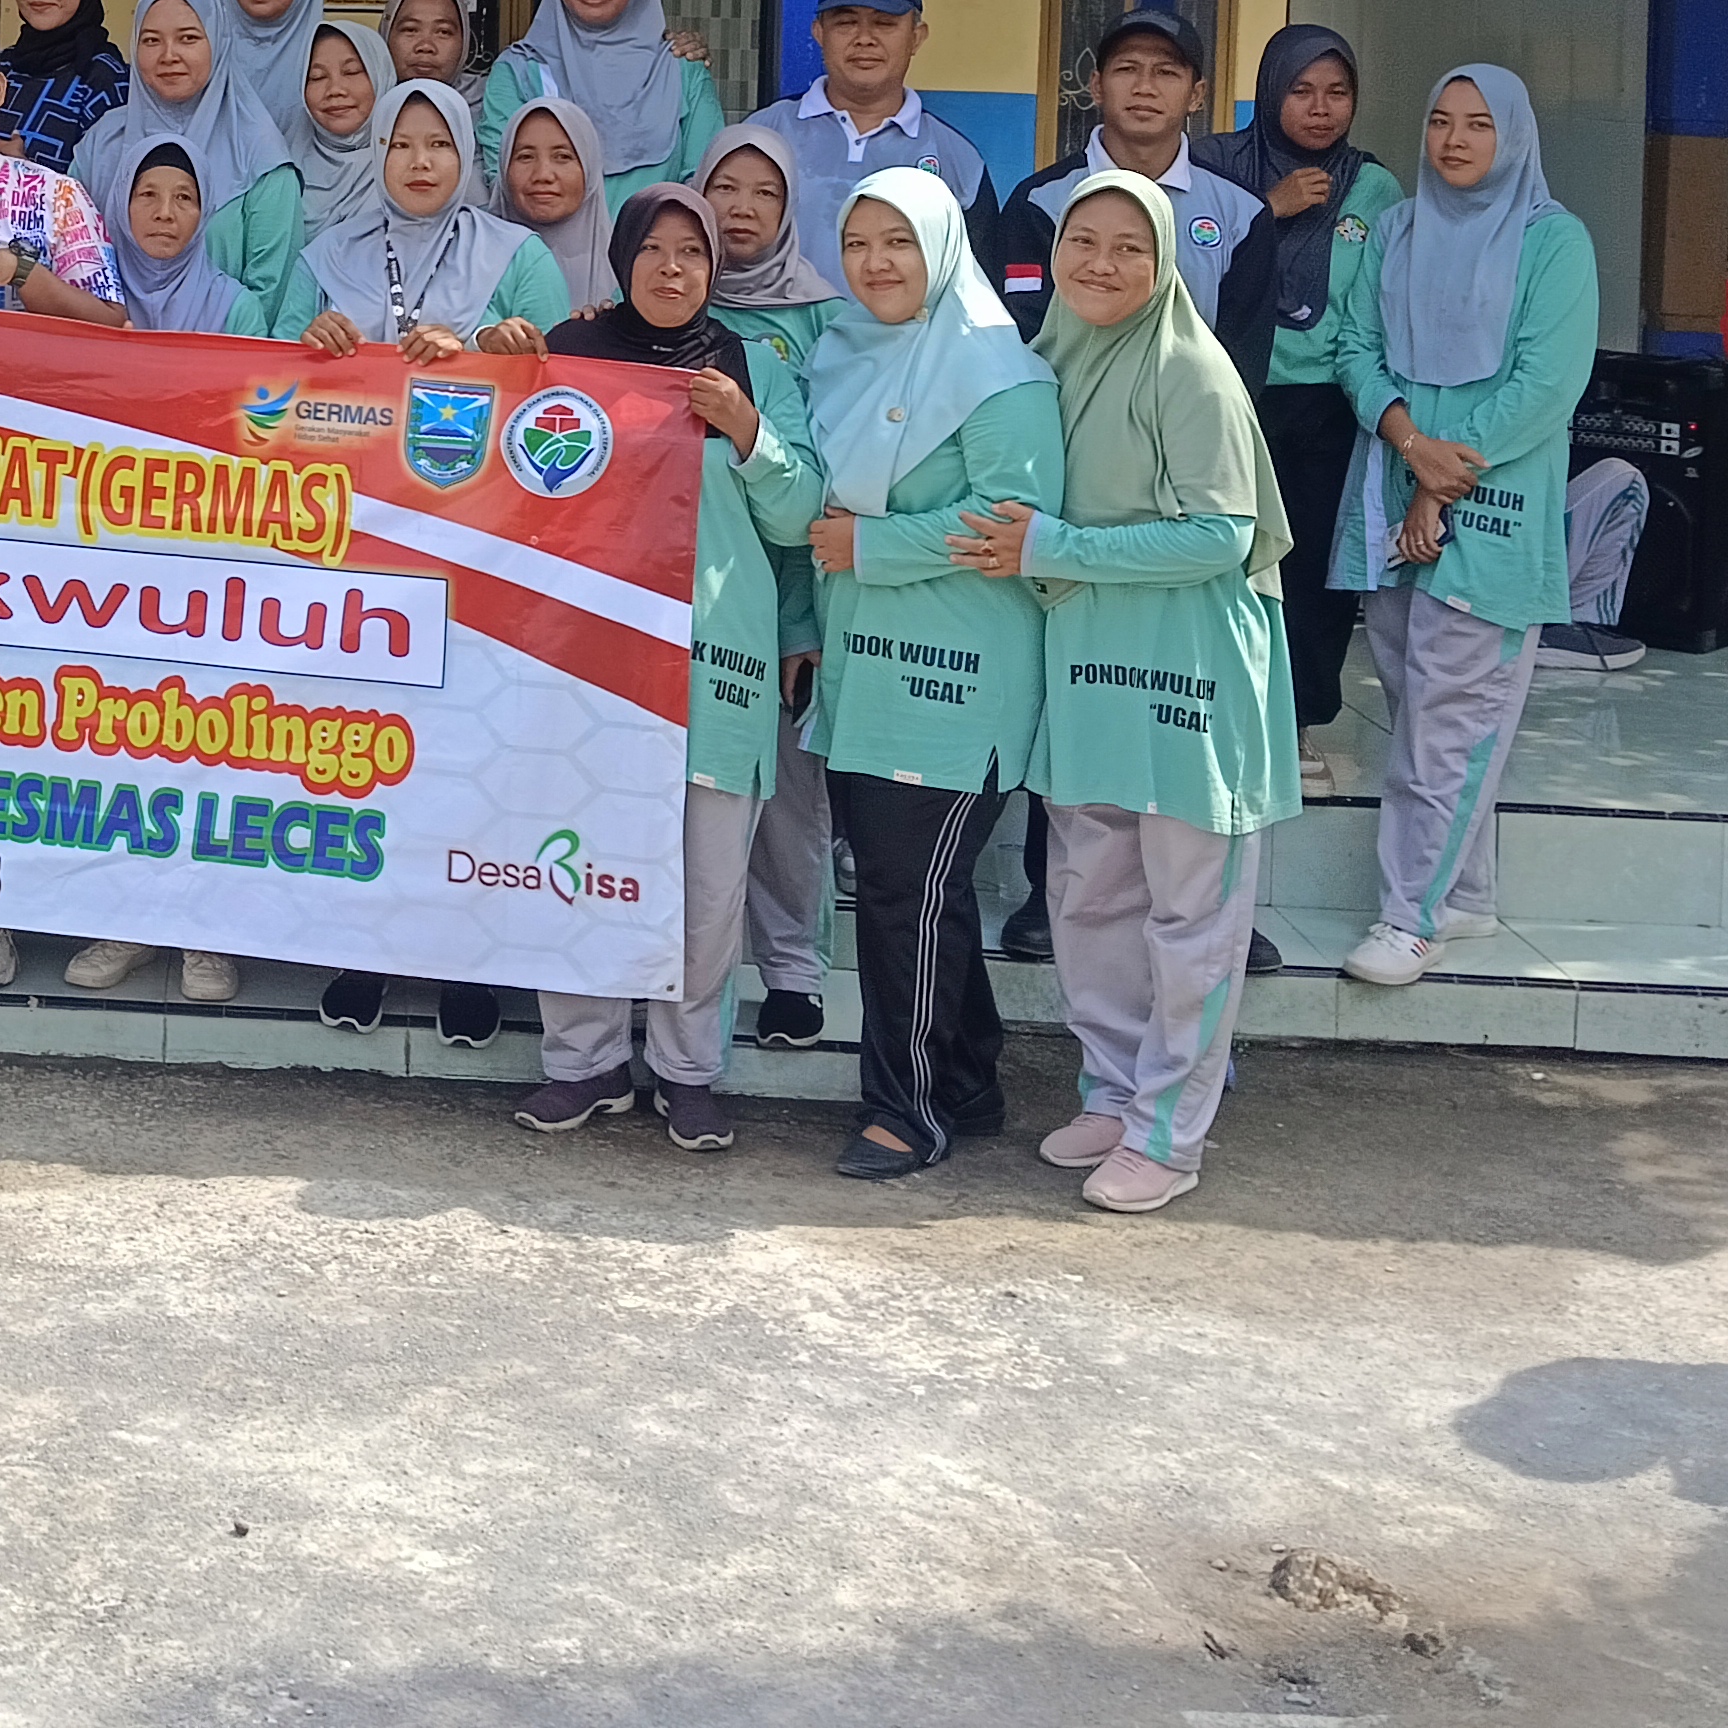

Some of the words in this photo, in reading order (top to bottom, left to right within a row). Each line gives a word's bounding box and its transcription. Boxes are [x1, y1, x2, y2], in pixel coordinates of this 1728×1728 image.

[295, 400, 394, 427] GERMAS
[80, 449, 350, 560] (GERMAS)
[710, 646, 767, 682] WULUH
[899, 640, 981, 675] WULUH
[55, 672, 411, 792] Probolinggo
[193, 793, 384, 881] LECES
